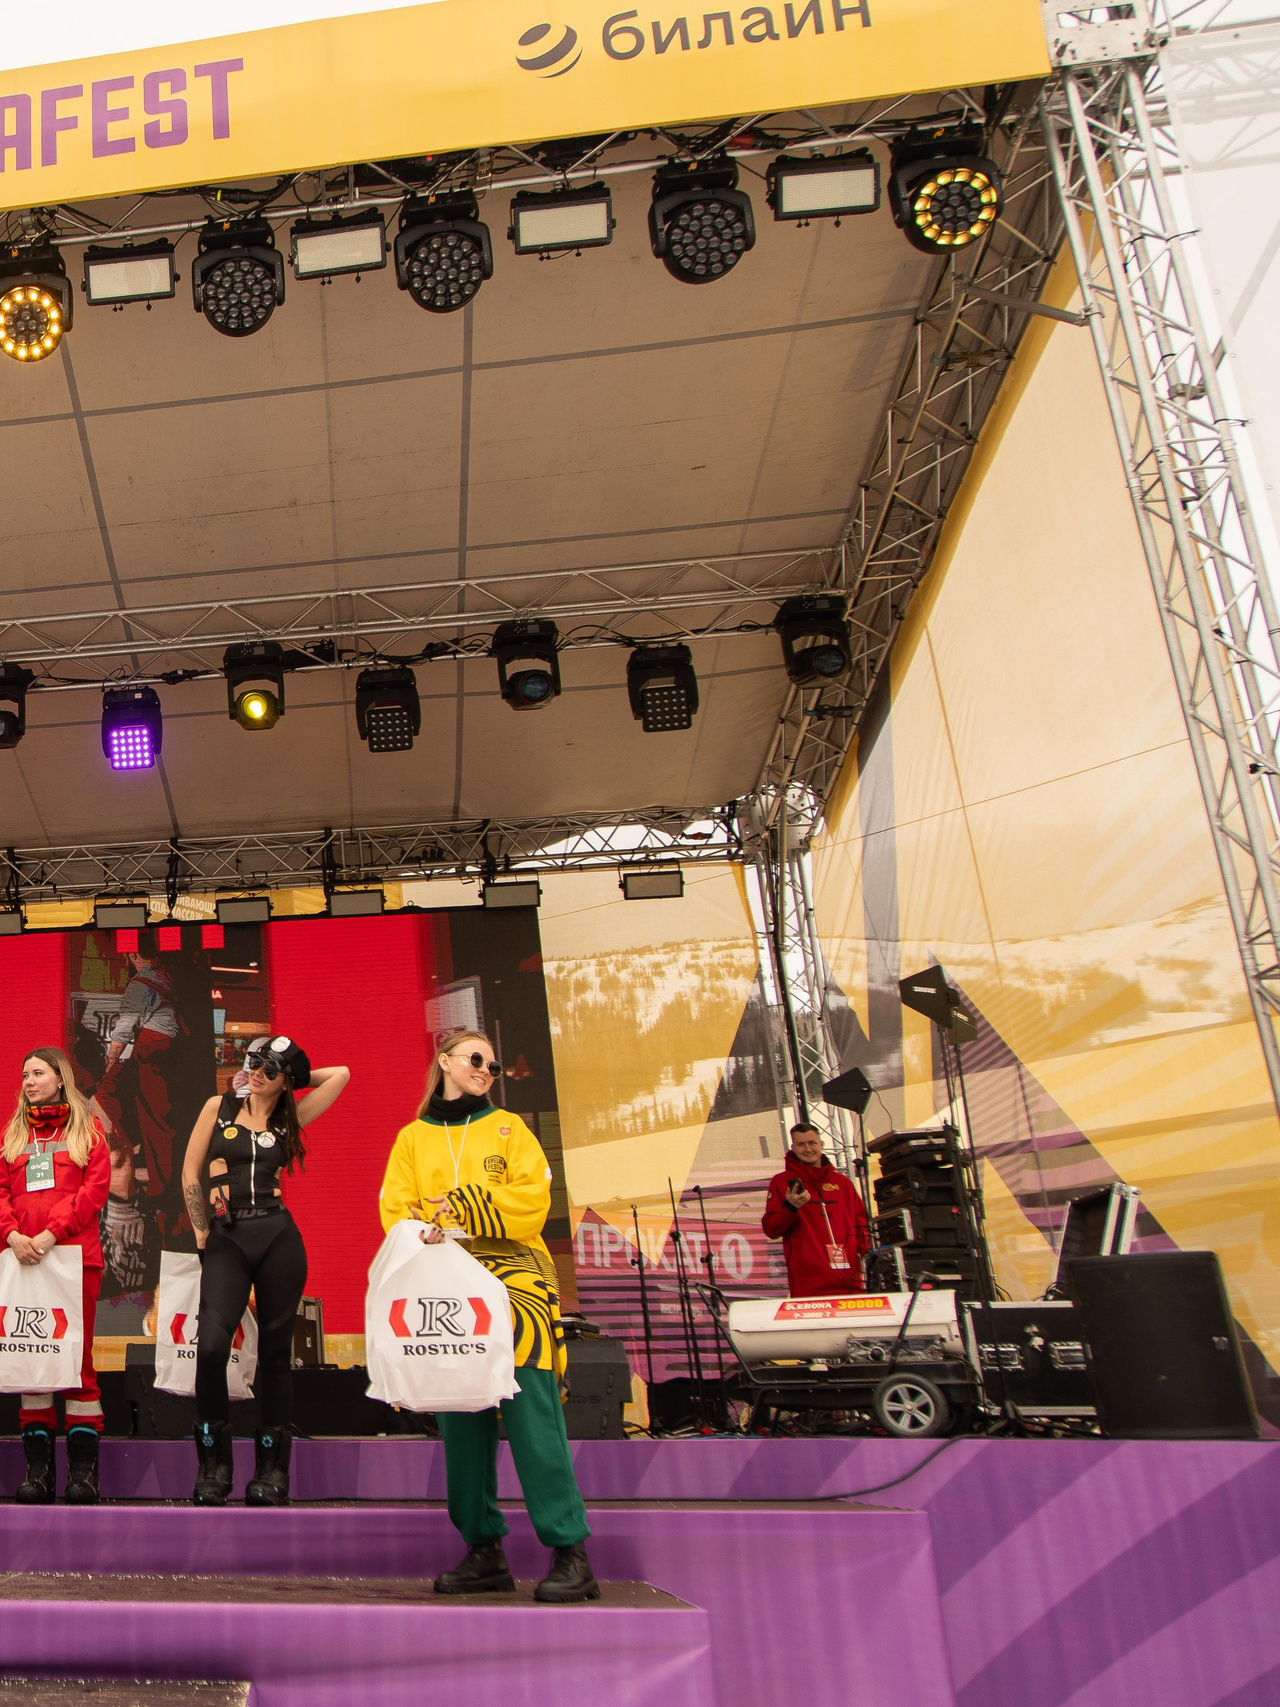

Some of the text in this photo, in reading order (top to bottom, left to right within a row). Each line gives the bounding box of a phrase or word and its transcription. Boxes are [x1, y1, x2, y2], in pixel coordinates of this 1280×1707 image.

[576, 1222, 707, 1275] ПРОКАТ
[838, 1299, 884, 1310] 30000
[402, 1342, 488, 1356] ROSTIC'S
